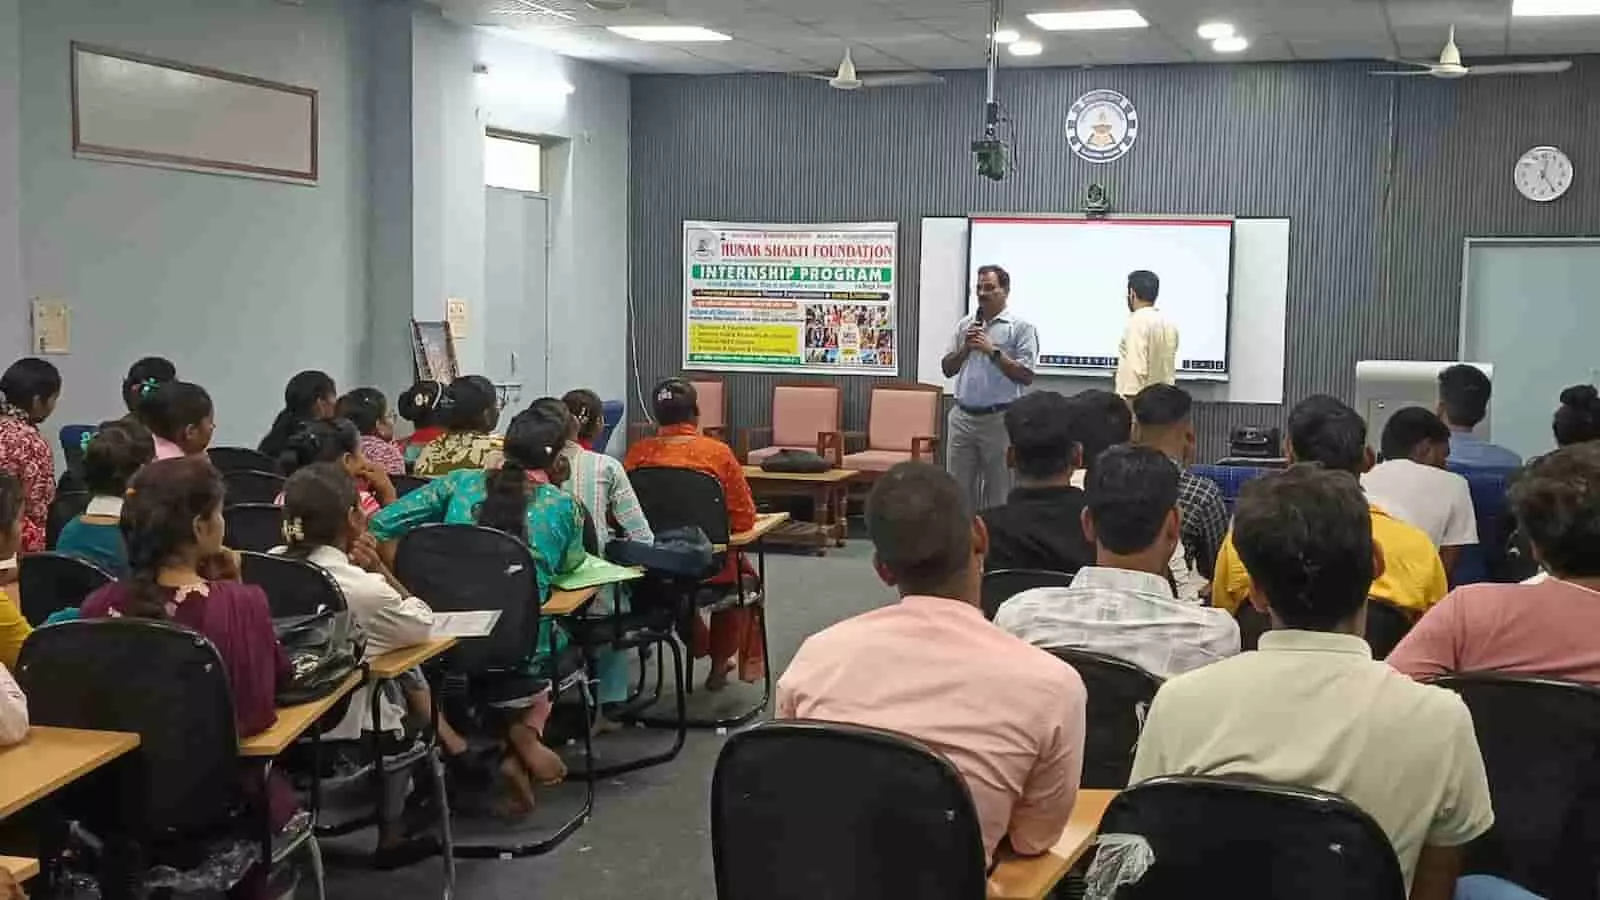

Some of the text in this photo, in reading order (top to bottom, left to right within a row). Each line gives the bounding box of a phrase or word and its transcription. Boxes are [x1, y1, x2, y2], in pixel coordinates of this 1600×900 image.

[721, 243, 892, 259] HUNAR SHAKTI FOUNDATION
[701, 265, 882, 281] INTERNSHIP PROGRAM
